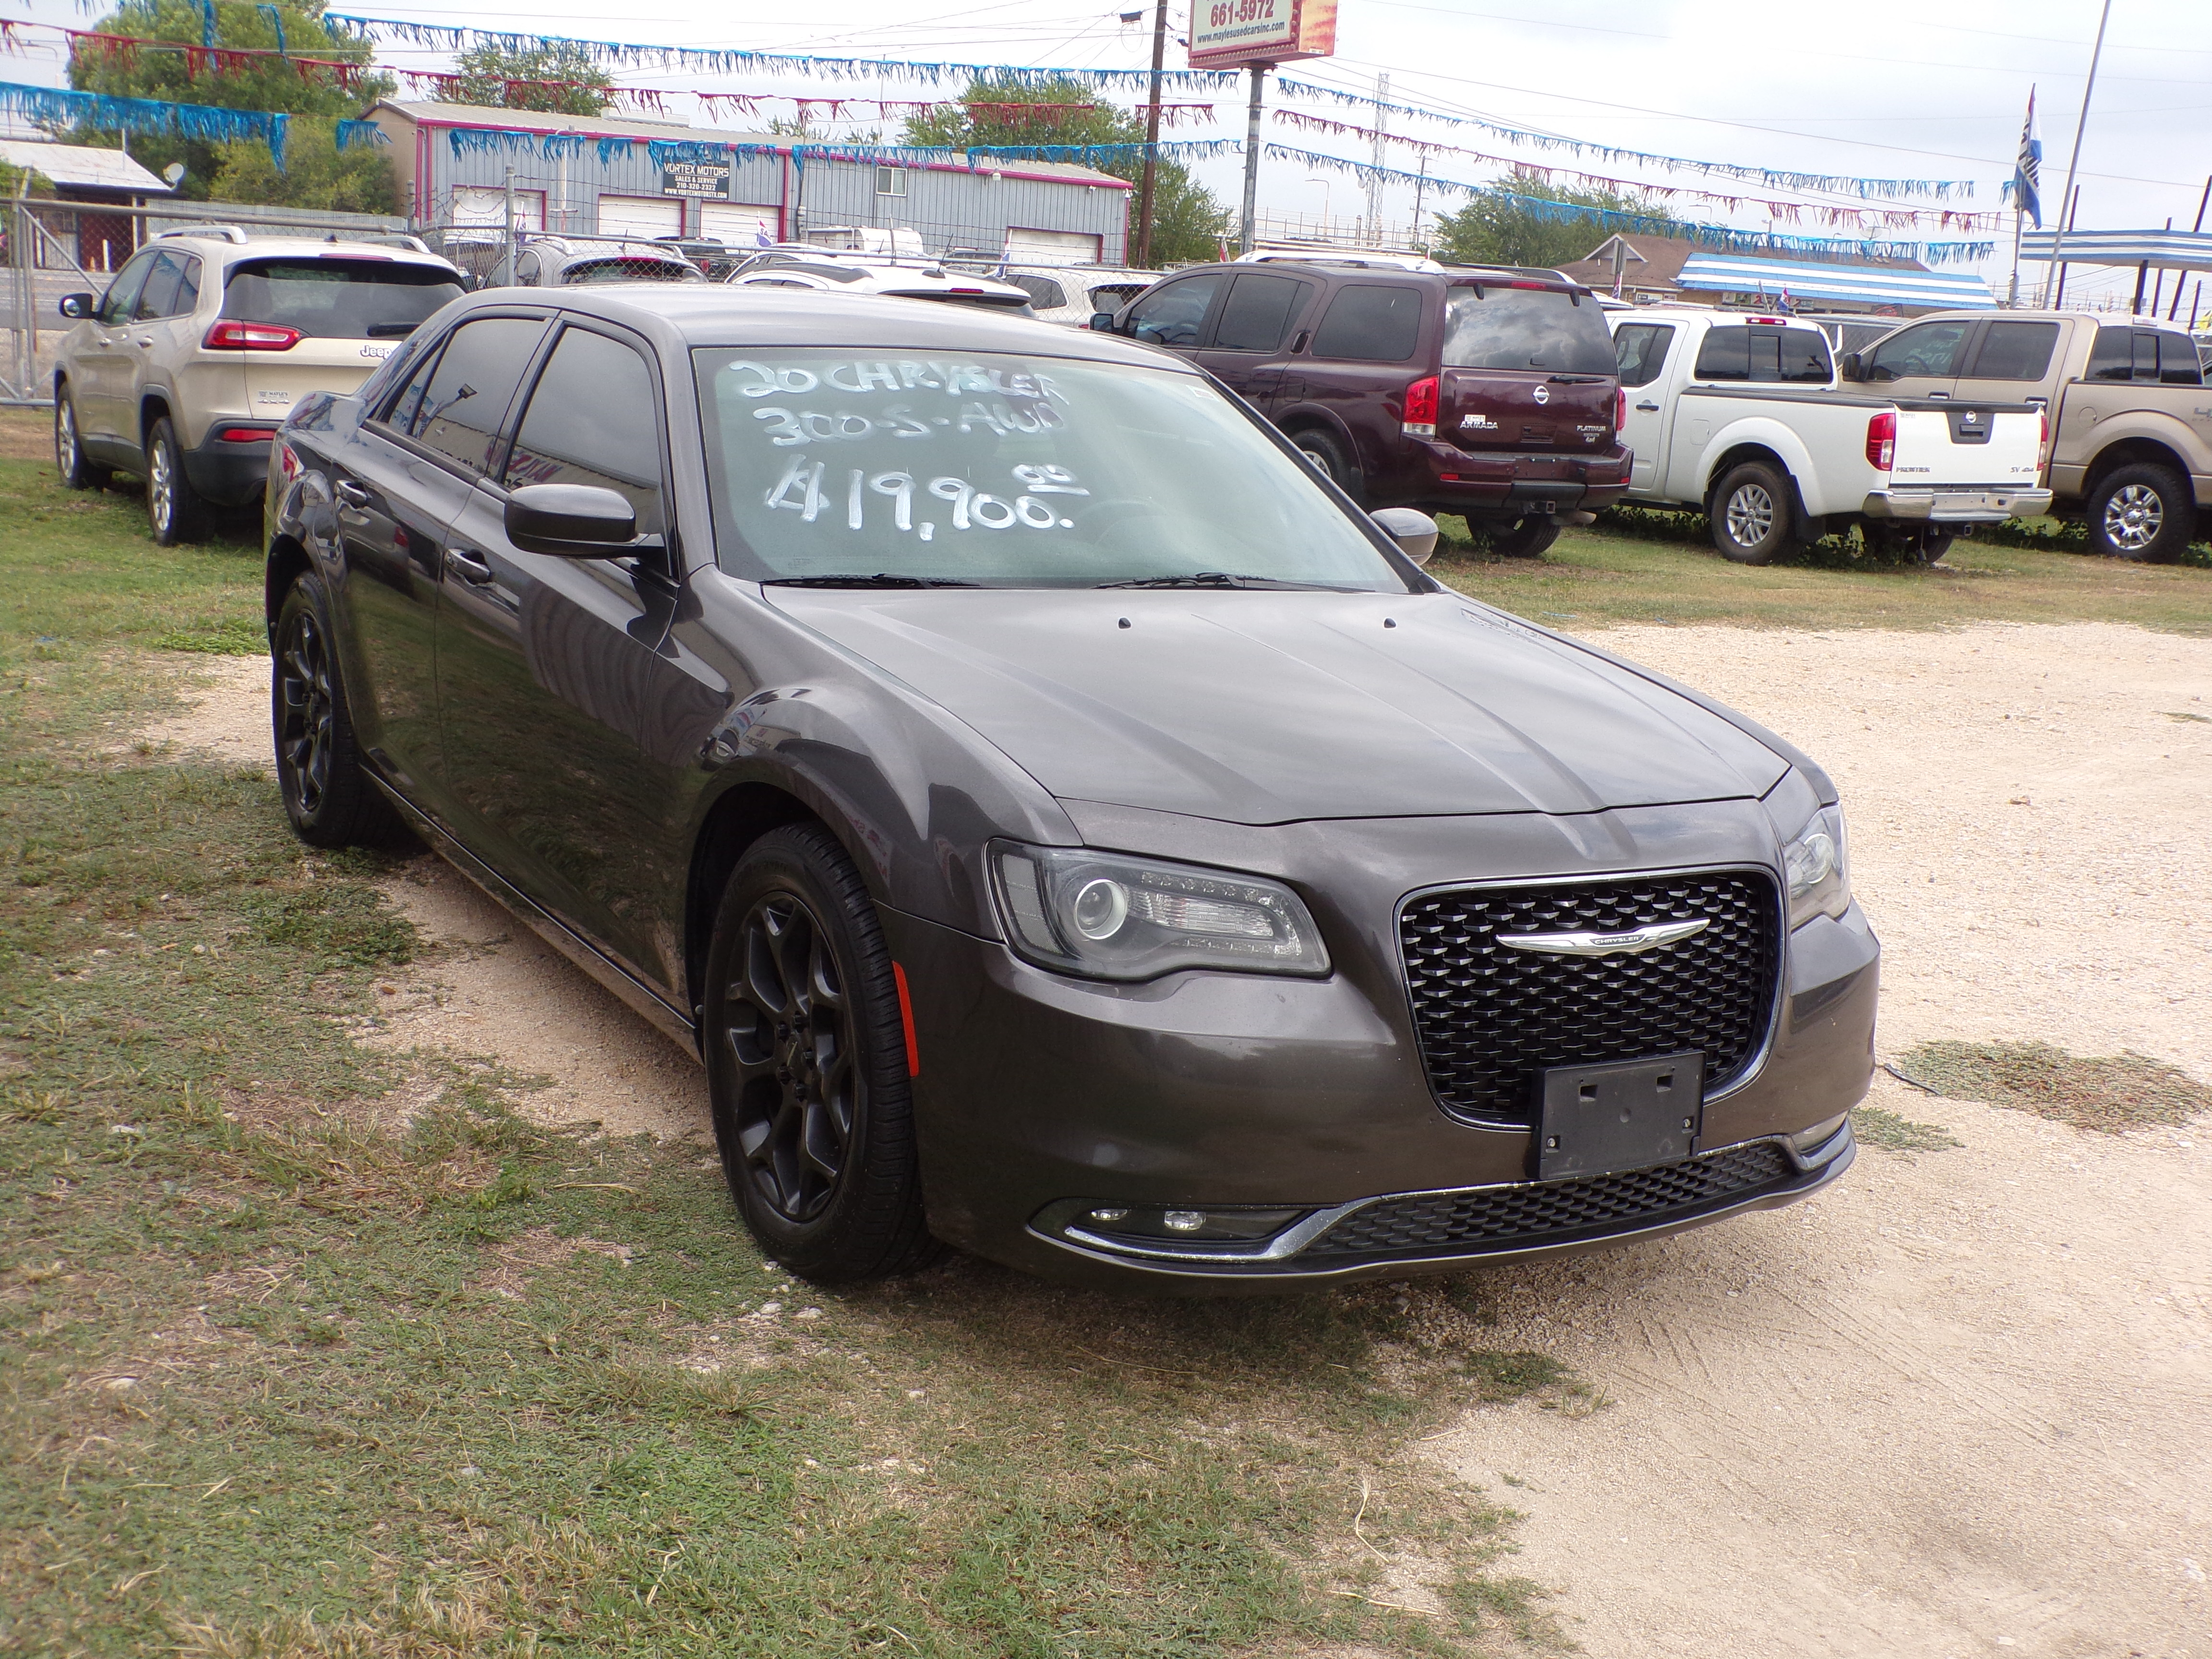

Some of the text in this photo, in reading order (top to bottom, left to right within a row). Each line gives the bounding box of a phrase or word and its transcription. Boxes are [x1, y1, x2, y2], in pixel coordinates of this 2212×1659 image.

[1210, 0, 1274, 27] 661-5972
[1197, 21, 1285, 44] www.maylesusedcarsinc.com
[664, 162, 729, 177] VORTEX MOTORS
[676, 182, 716, 191] 210-320-2322
[664, 188, 727, 199] WWW.VORTEXMOTORSTX.COM
[360, 345, 392, 360] Jeep
[1459, 421, 1498, 430] ARMADA
[1595, 936, 1639, 944] CHRYSLER
